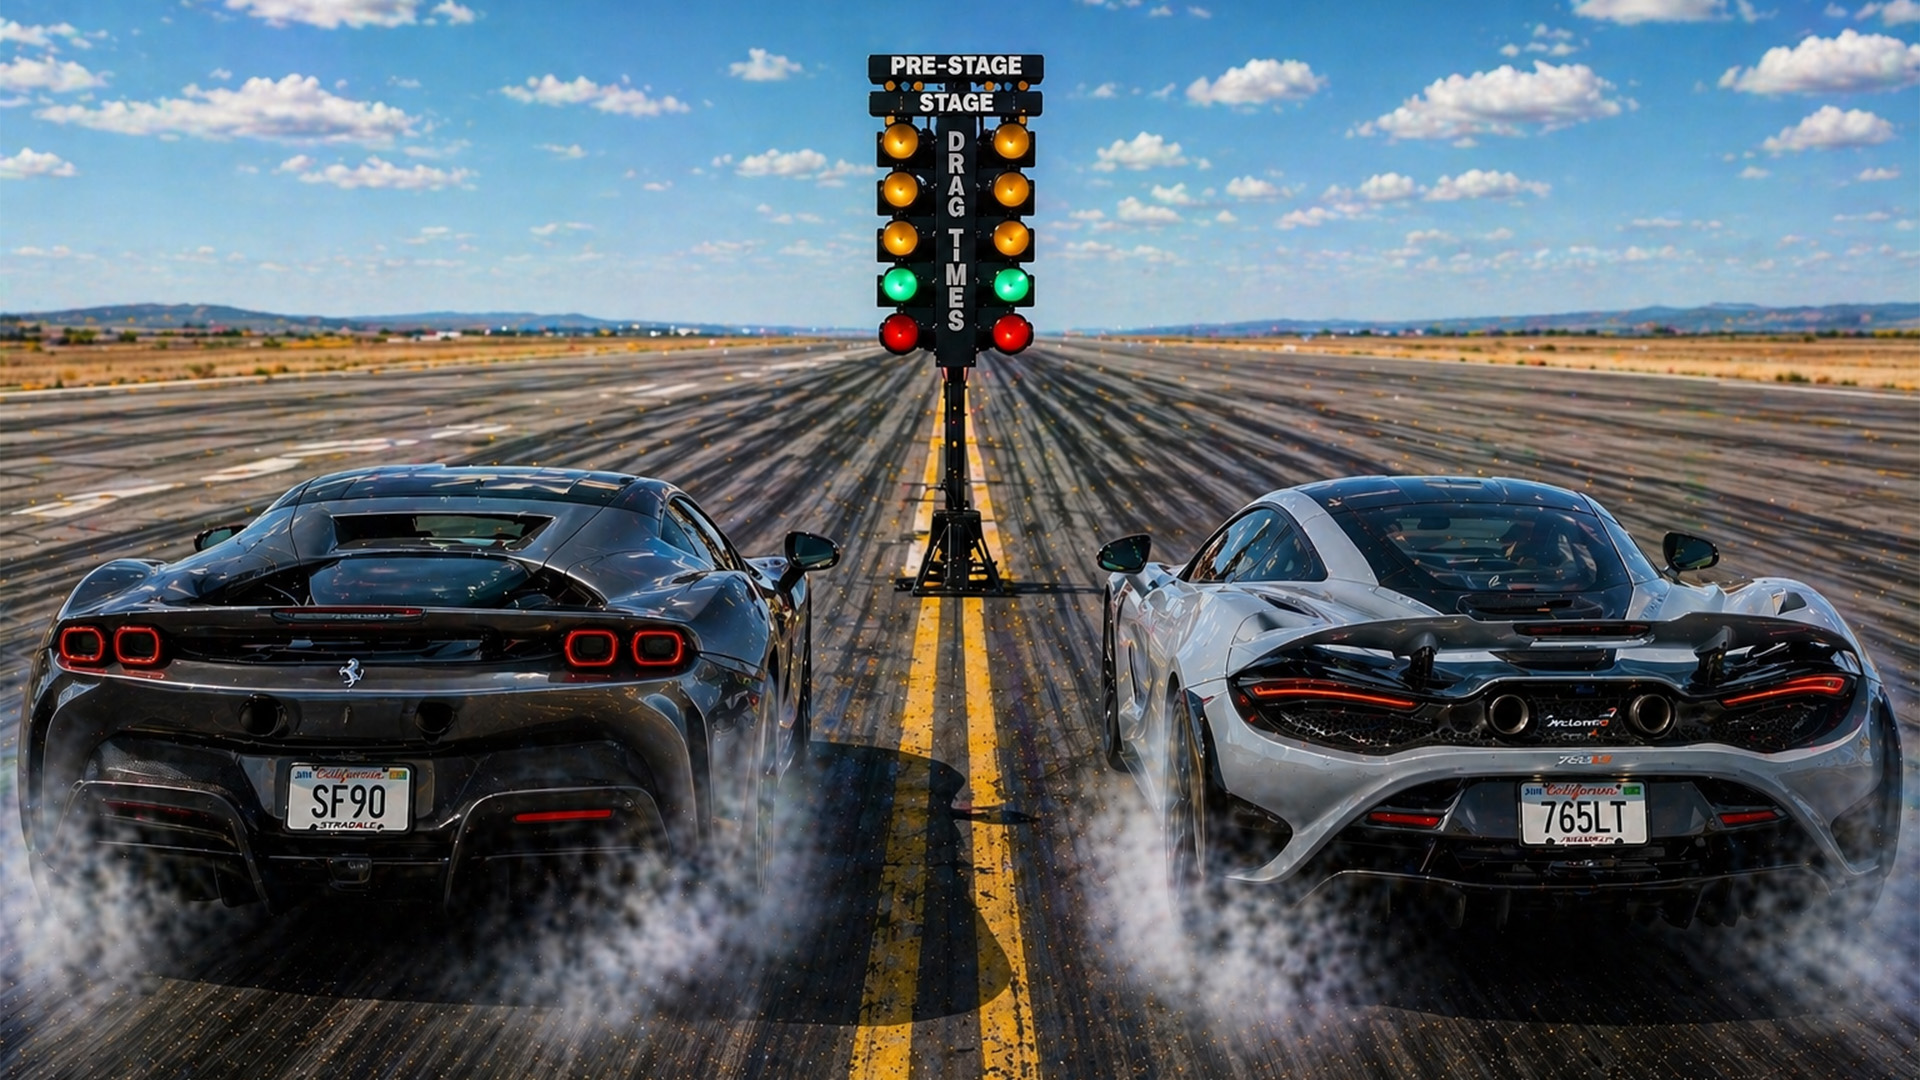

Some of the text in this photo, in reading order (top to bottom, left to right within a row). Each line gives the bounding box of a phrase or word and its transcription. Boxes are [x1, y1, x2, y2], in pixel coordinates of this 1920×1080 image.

[890, 56, 1023, 75] PRE-STAGE
[919, 93, 995, 112] STAGE
[945, 131, 967, 332] DRAG TIMES
[311, 784, 386, 819] SF90
[320, 821, 377, 829] STRADALE
[1540, 800, 1627, 833] 765LT
